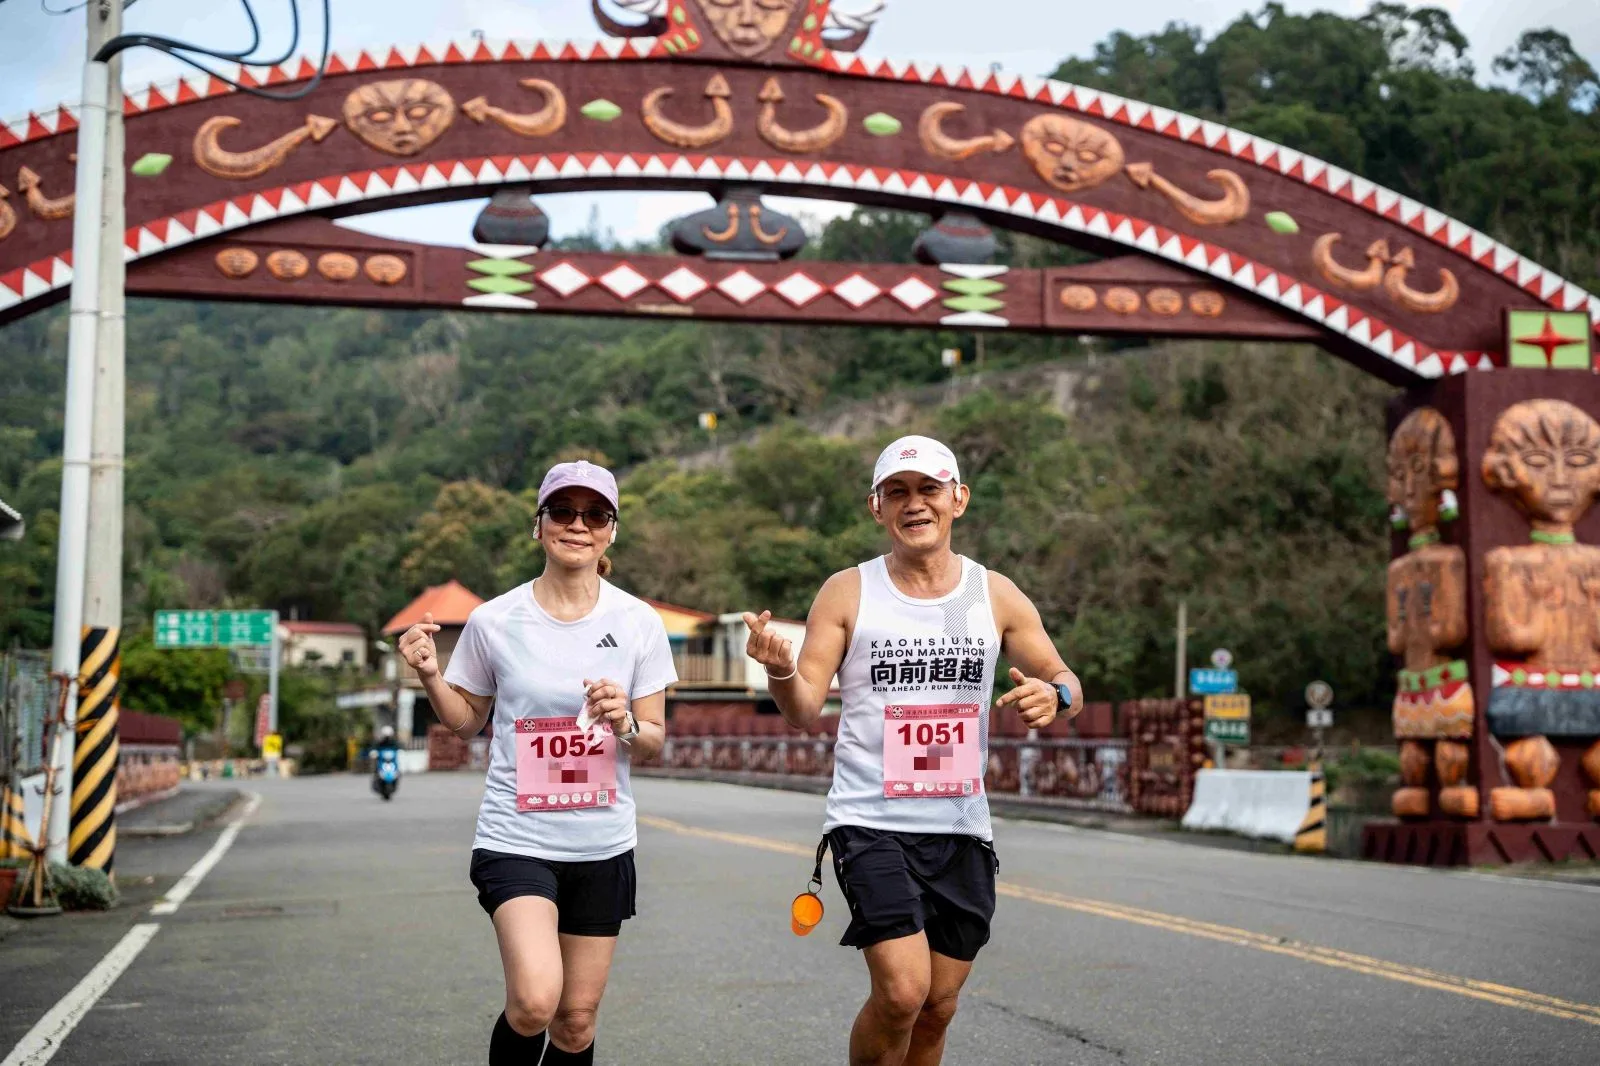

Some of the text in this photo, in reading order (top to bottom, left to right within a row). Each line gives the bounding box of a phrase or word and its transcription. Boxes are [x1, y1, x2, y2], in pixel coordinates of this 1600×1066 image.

[871, 637, 985, 649] KAOHSIUNG
[871, 647, 985, 659] FUBON MARATHON
[871, 658, 984, 685] 向前超越
[897, 722, 964, 745] 1051
[530, 734, 604, 759] 1052
